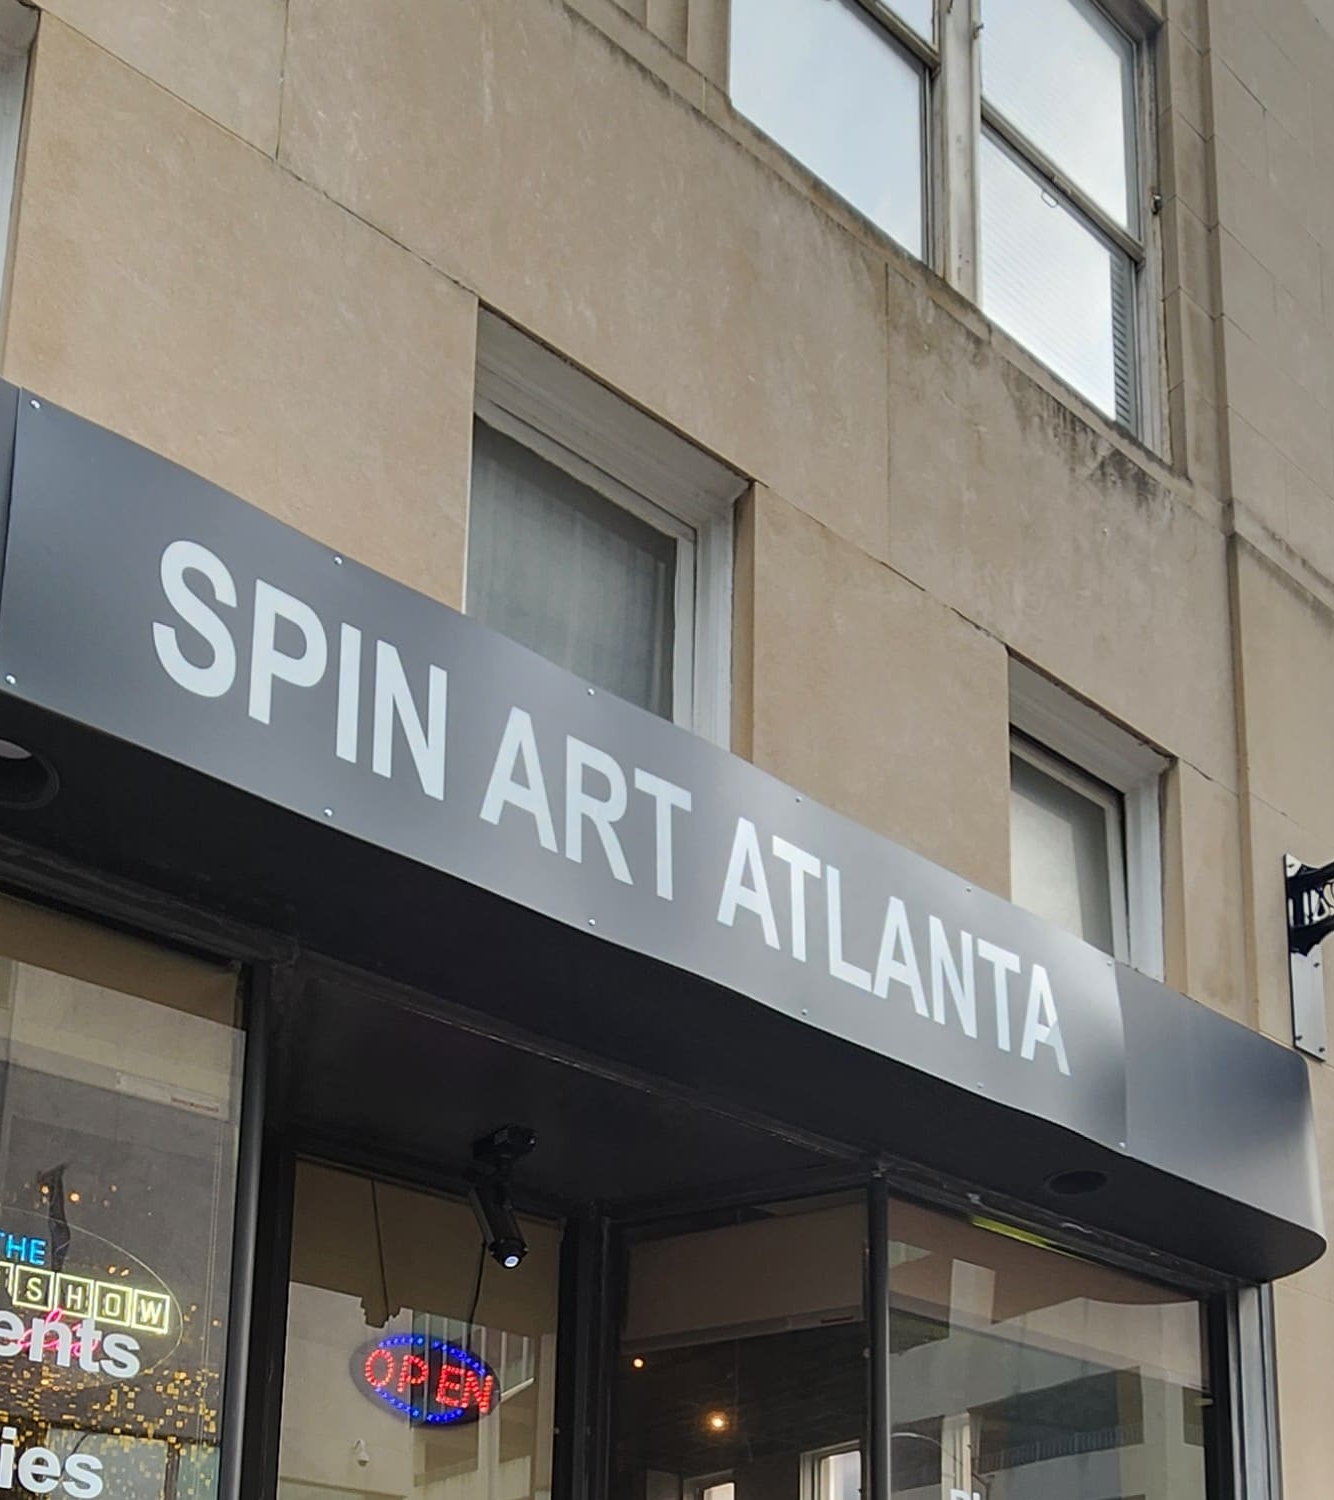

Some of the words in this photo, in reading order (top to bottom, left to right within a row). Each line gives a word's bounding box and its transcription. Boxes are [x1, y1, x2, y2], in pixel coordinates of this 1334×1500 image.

[150, 539, 448, 800] SPIN
[479, 706, 693, 903] ART
[715, 816, 1071, 1076] ATLANTA
[364, 1349, 493, 1414] OPEN
